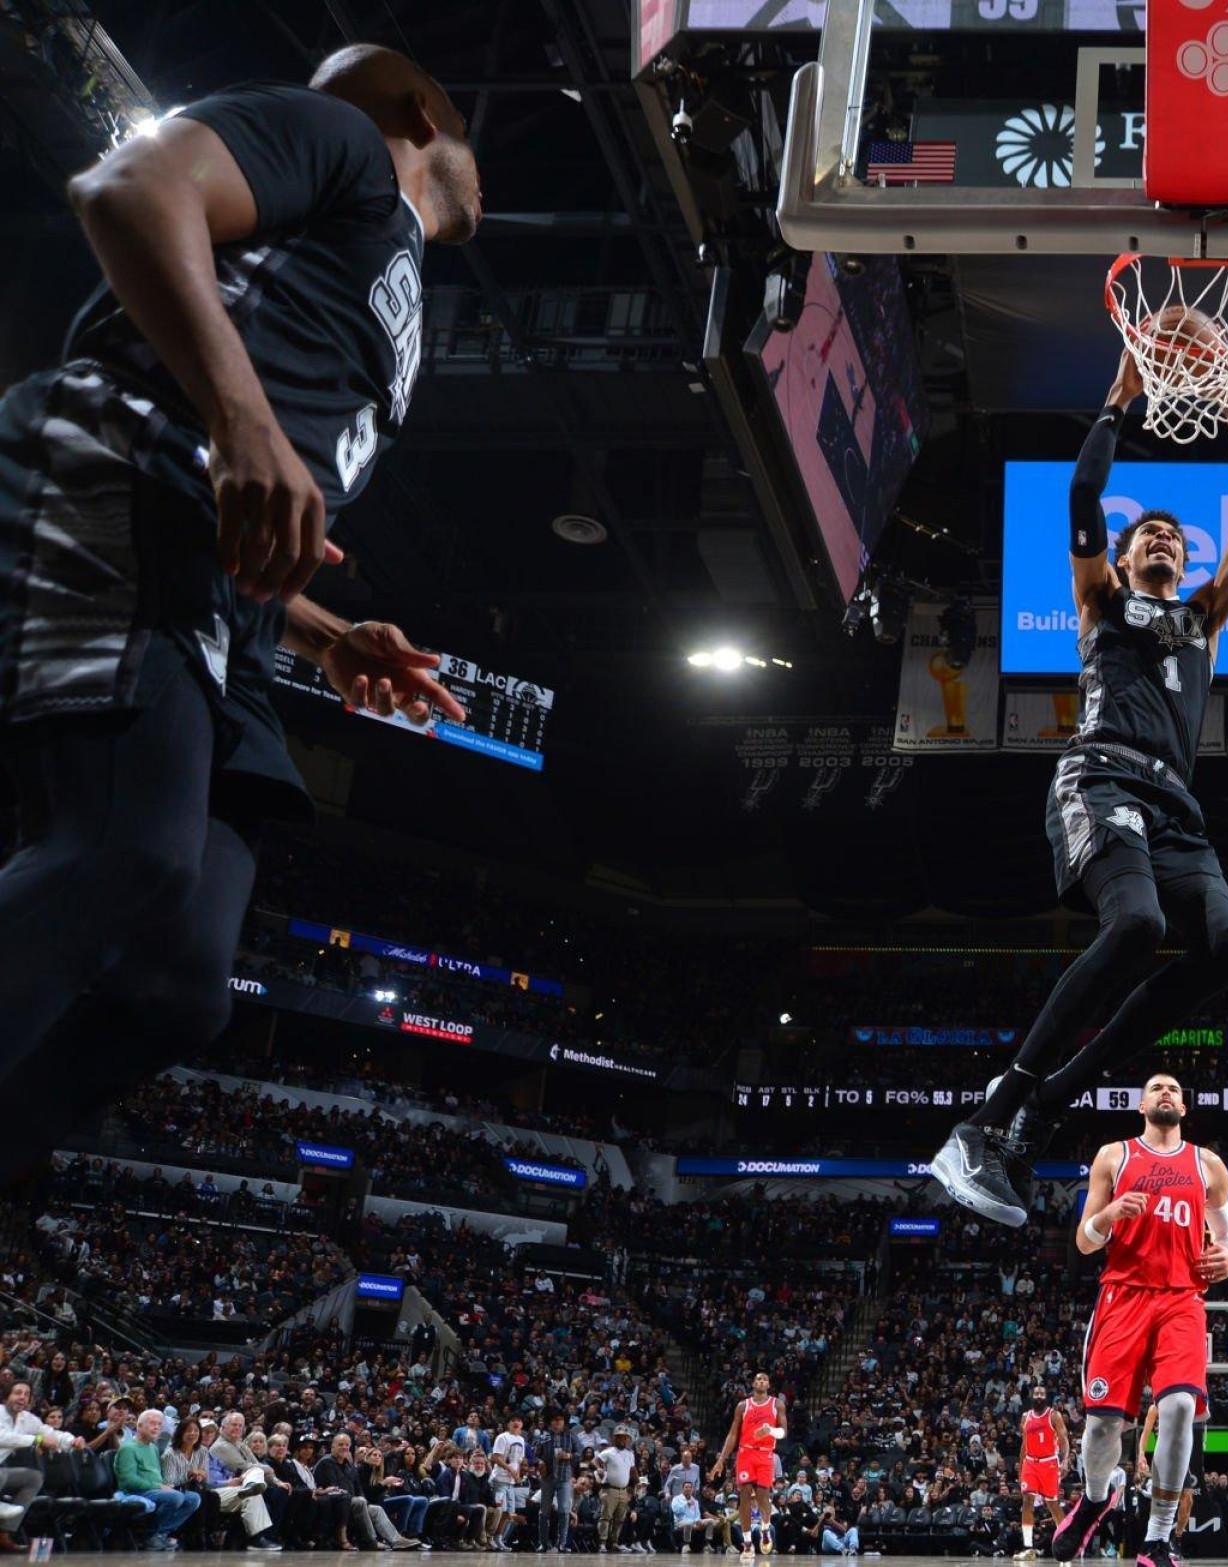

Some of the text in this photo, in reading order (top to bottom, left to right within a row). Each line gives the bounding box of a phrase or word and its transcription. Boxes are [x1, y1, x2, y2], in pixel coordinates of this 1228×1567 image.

[449, 658, 508, 691] 36 LAC
[1163, 656, 1182, 692] 1
[744, 757, 789, 768] 1999
[799, 757, 852, 768] 2003
[861, 756, 914, 767] 2005
[403, 1012, 440, 1030] WEST
[440, 1020, 474, 1036] LOOP
[563, 1049, 614, 1069] Methodist
[807, 1095, 815, 1108] 2
[835, 1090, 860, 1104] TO
[865, 1089, 874, 1105] 5
[885, 1091, 930, 1105] FG%
[961, 1091, 985, 1105] PF
[1109, 1091, 1130, 1109] 59
[1197, 1092, 1220, 1106] 2ND
[517, 1164, 577, 1182] DOCUMATION
[747, 1162, 820, 1174] DOCUMATION
[1151, 1161, 1173, 1177] Los
[1131, 1173, 1193, 1195] Angeles
[1153, 1195, 1191, 1227] 40
[1038, 1432, 1045, 1443] 1
